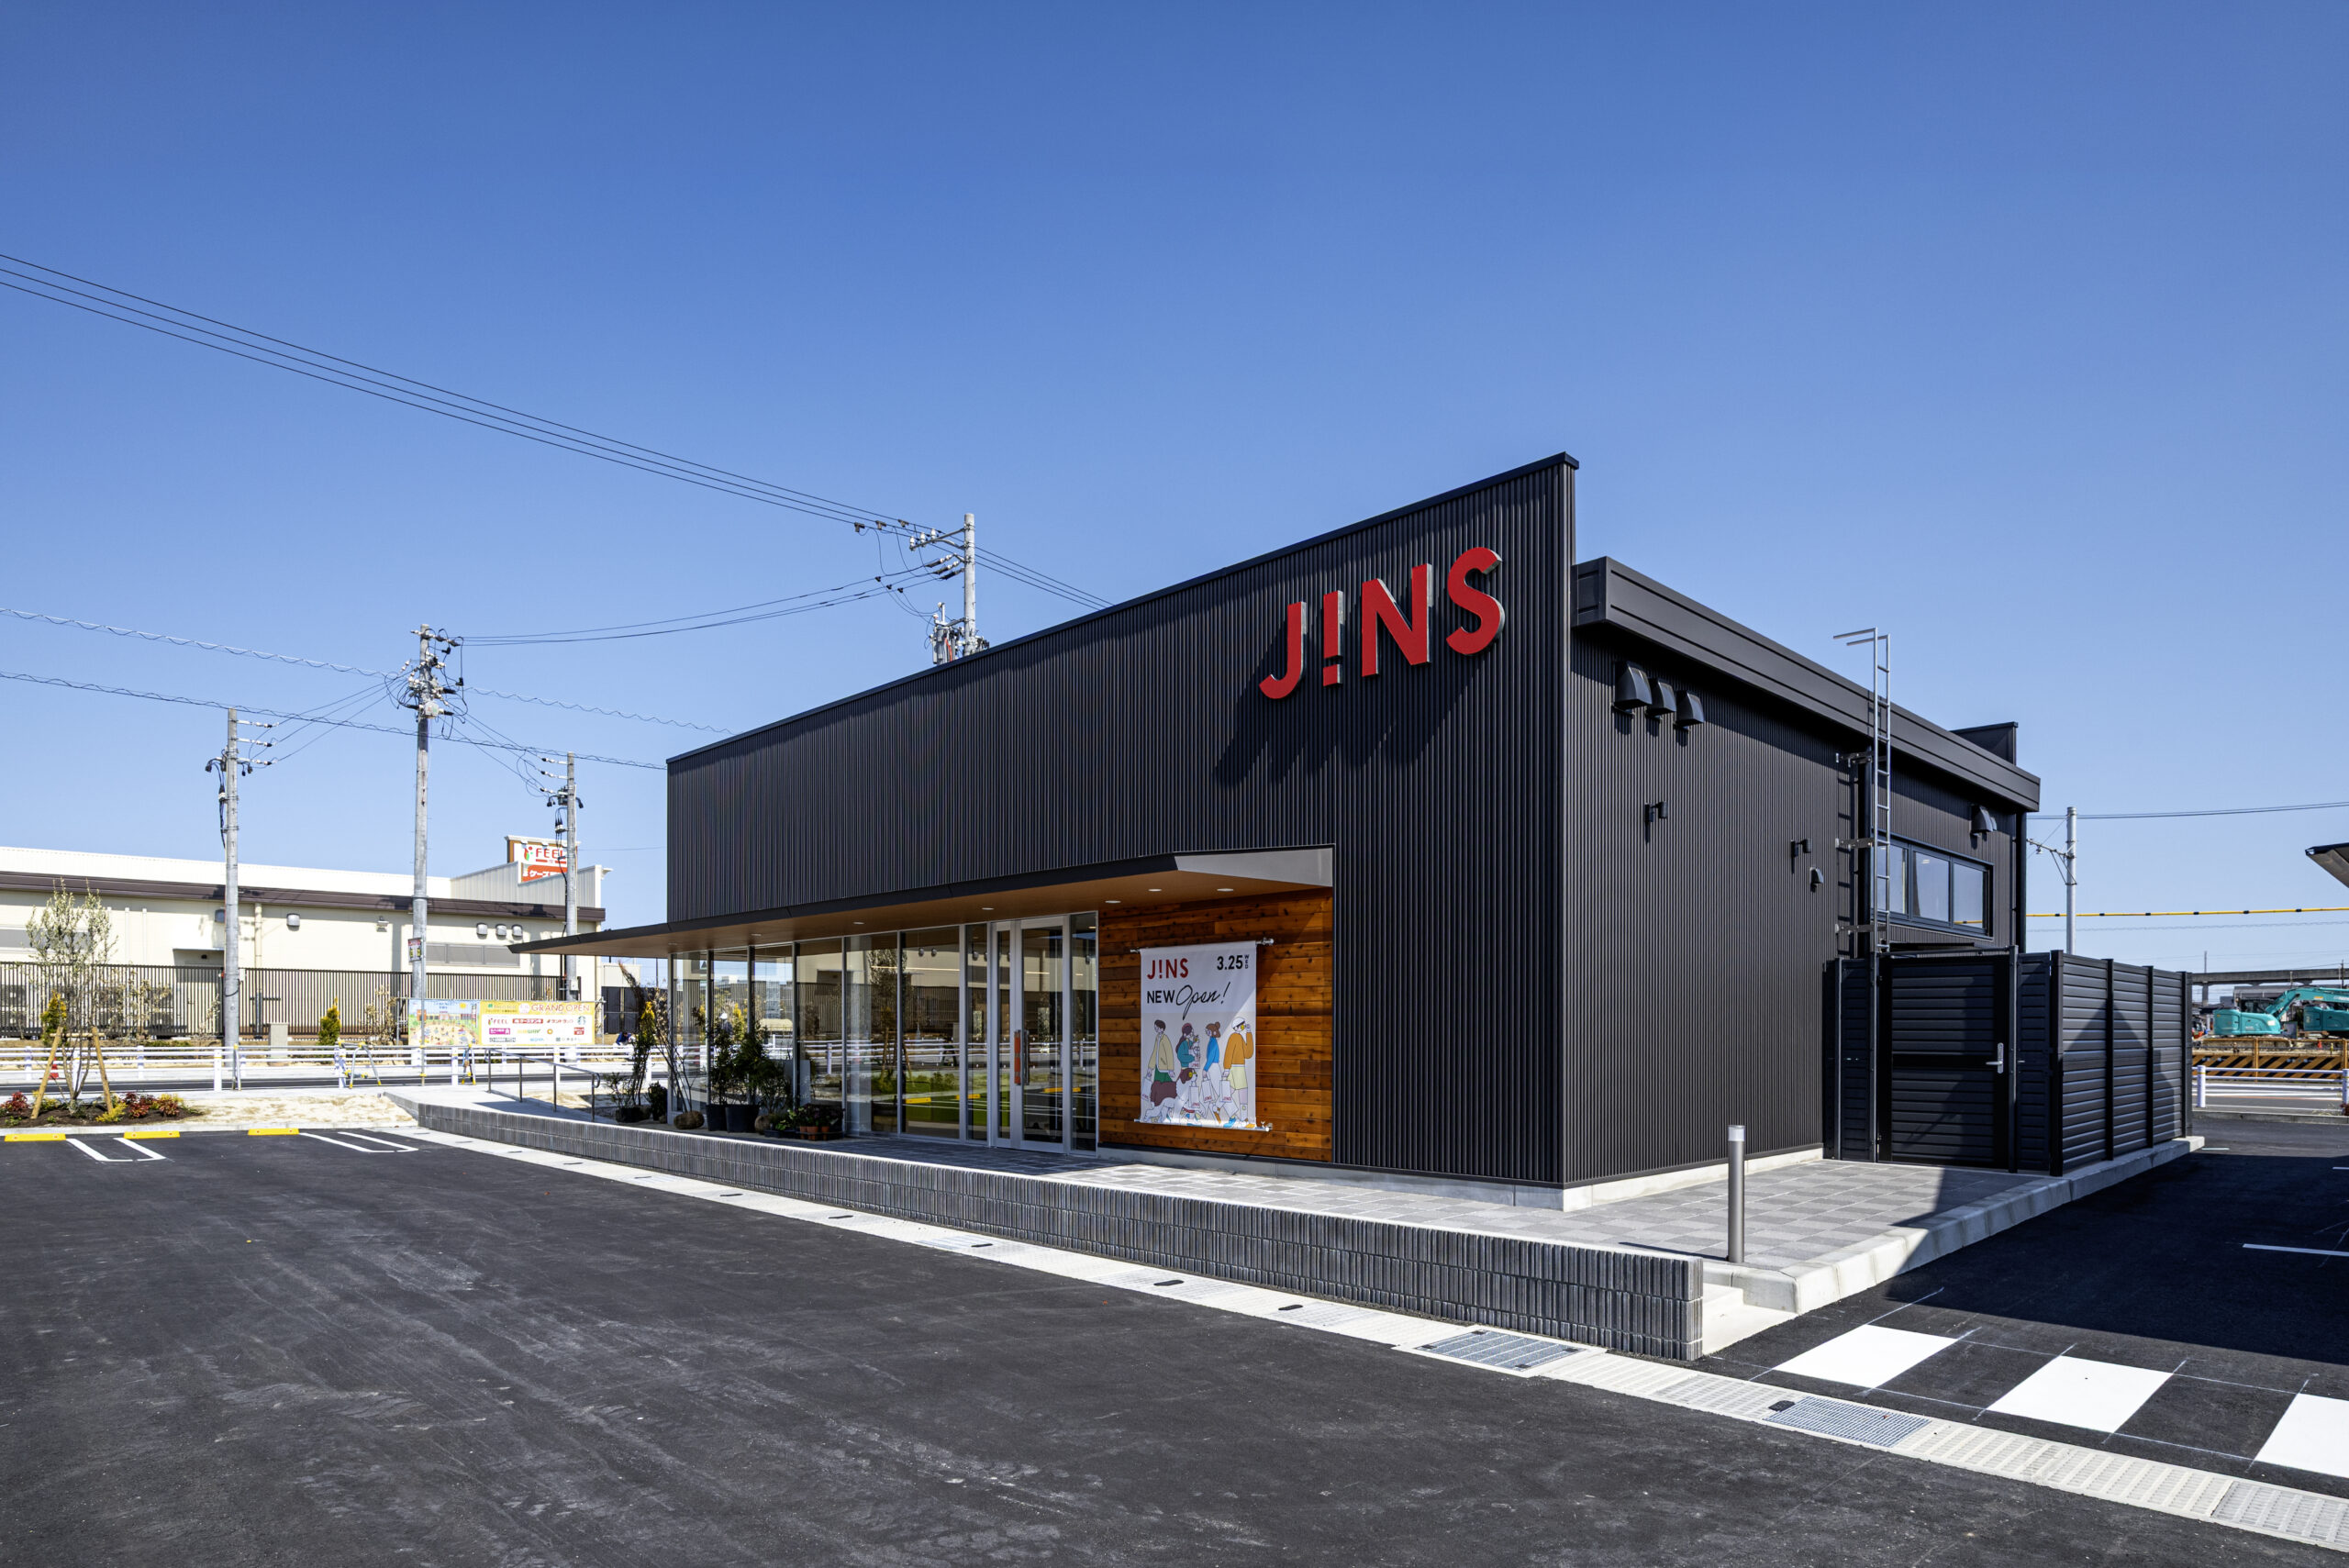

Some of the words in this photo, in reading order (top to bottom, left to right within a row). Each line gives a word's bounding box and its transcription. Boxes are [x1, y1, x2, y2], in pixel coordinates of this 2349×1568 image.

[1217, 955, 1243, 970] 3.25
[1147, 989, 1175, 1004] NEW
[531, 1004, 564, 1012] GRAND
